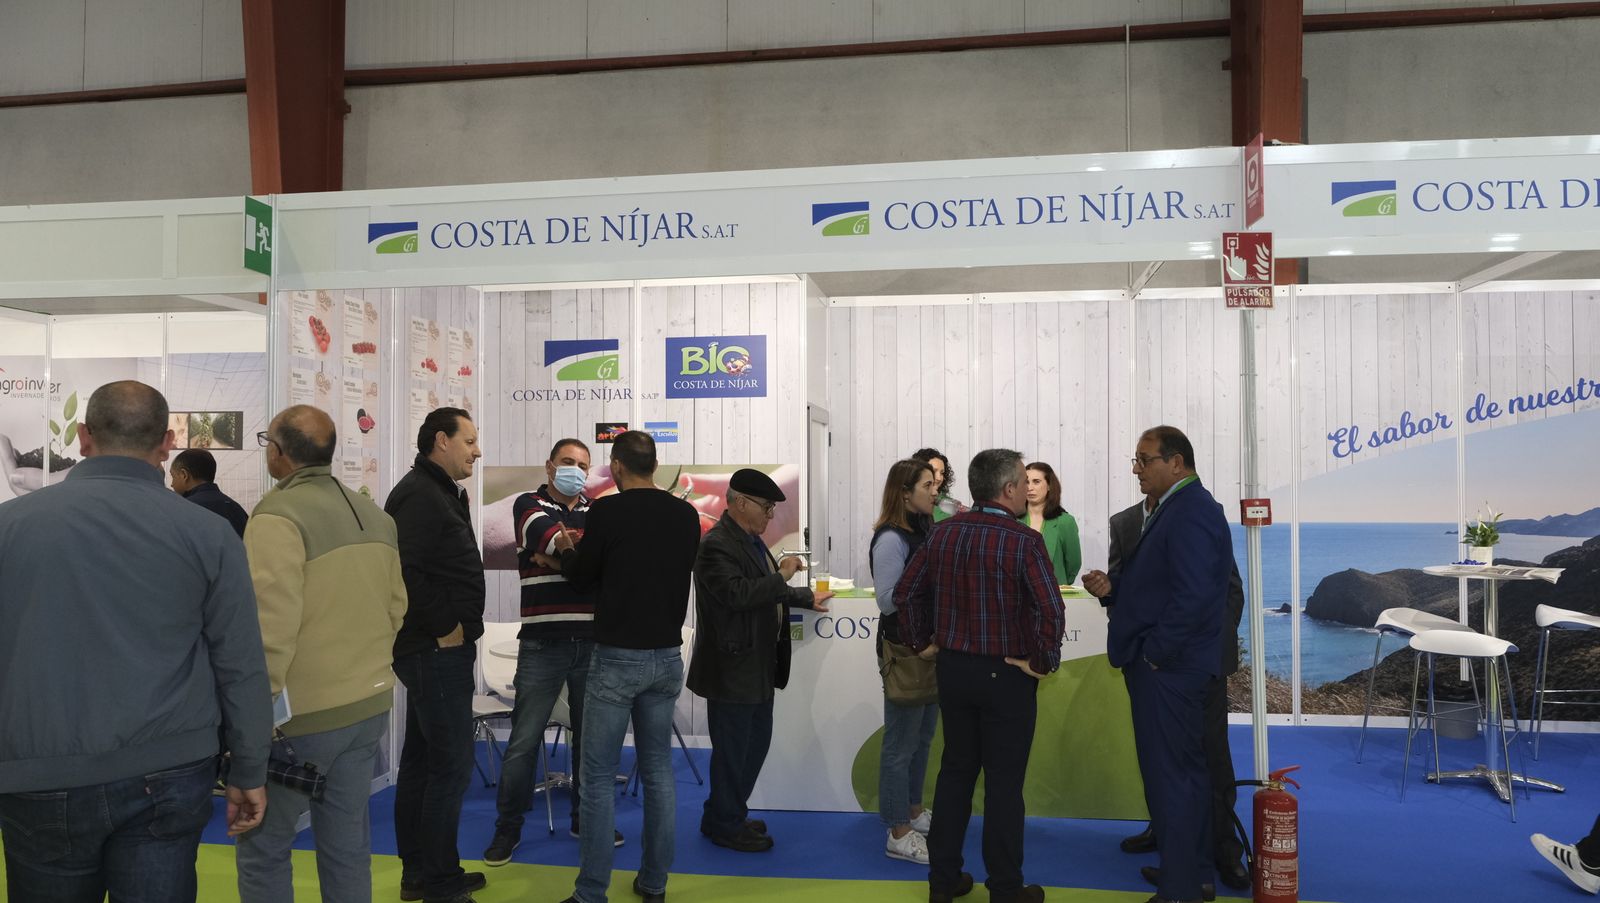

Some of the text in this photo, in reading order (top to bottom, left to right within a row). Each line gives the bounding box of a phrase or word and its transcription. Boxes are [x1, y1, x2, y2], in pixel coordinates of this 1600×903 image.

[1412, 179, 1548, 213] COSTA
[1560, 177, 1600, 209] D
[884, 198, 1005, 231] COSTA
[1016, 195, 1068, 227] DE
[1079, 185, 1190, 228] NÍJAR
[431, 219, 535, 249] COSTA
[546, 216, 591, 244] DE
[600, 207, 699, 248] NÍJAR
[1227, 288, 1270, 297] PULSADOR
[1228, 297, 1271, 306] DE ALARMA
[0, 377, 62, 394] groinver
[673, 378, 759, 390] COSTA DE NÍJAR
[512, 389, 561, 402] COSTA
[565, 389, 586, 401] DE
[590, 386, 633, 403] NÍJAR
[1327, 425, 1363, 459] El
[1368, 411, 1453, 448] sabor
[1466, 393, 1503, 423] de
[815, 617, 880, 639] COS
